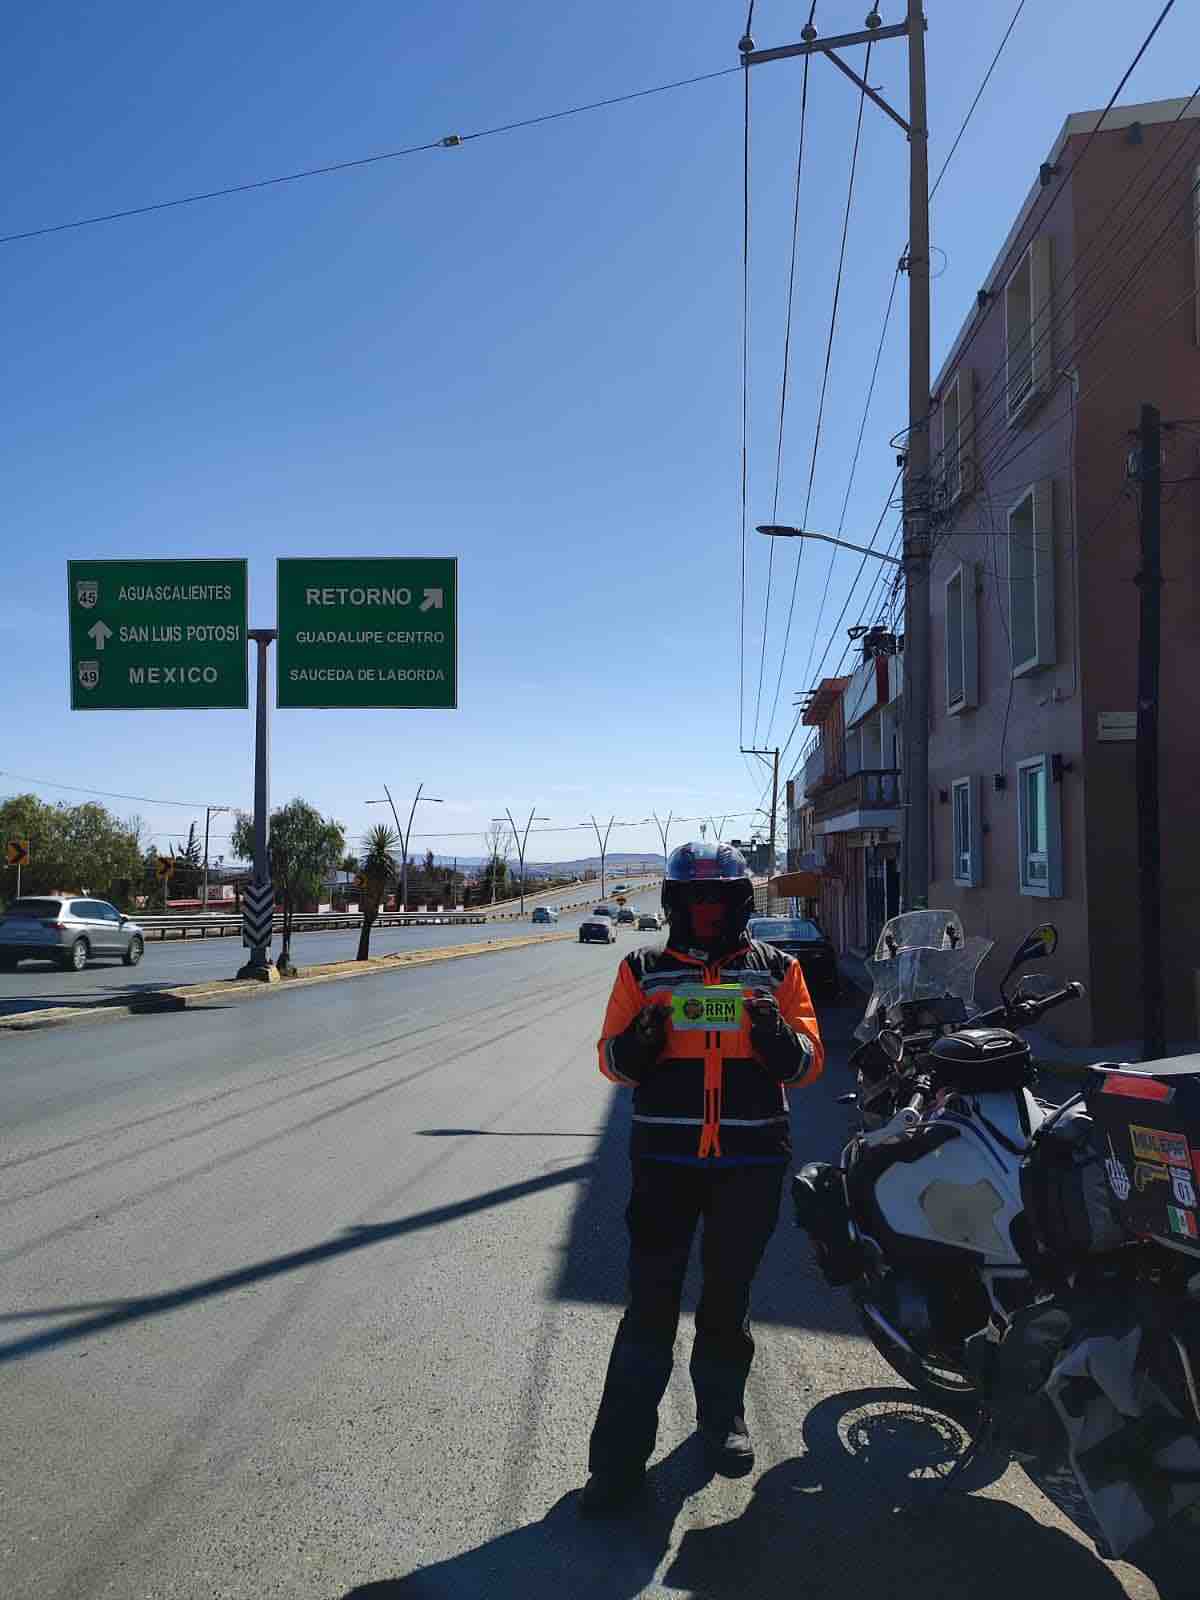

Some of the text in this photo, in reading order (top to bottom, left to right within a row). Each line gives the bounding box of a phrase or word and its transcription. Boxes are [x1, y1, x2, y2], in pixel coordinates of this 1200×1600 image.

[80, 591, 97, 604] 45
[118, 585, 232, 601] AGUASCALIENTES
[306, 587, 412, 606] RETORNO
[119, 626, 149, 642] SAN
[152, 625, 182, 641] LUIS
[296, 631, 445, 644] GUADALUPE CENTRO
[81, 671, 97, 683] 49
[129, 667, 218, 684] MEXICO
[289, 669, 354, 681] SAUCEDA
[358, 669, 375, 681] DE
[705, 1001, 736, 1017] RRM
